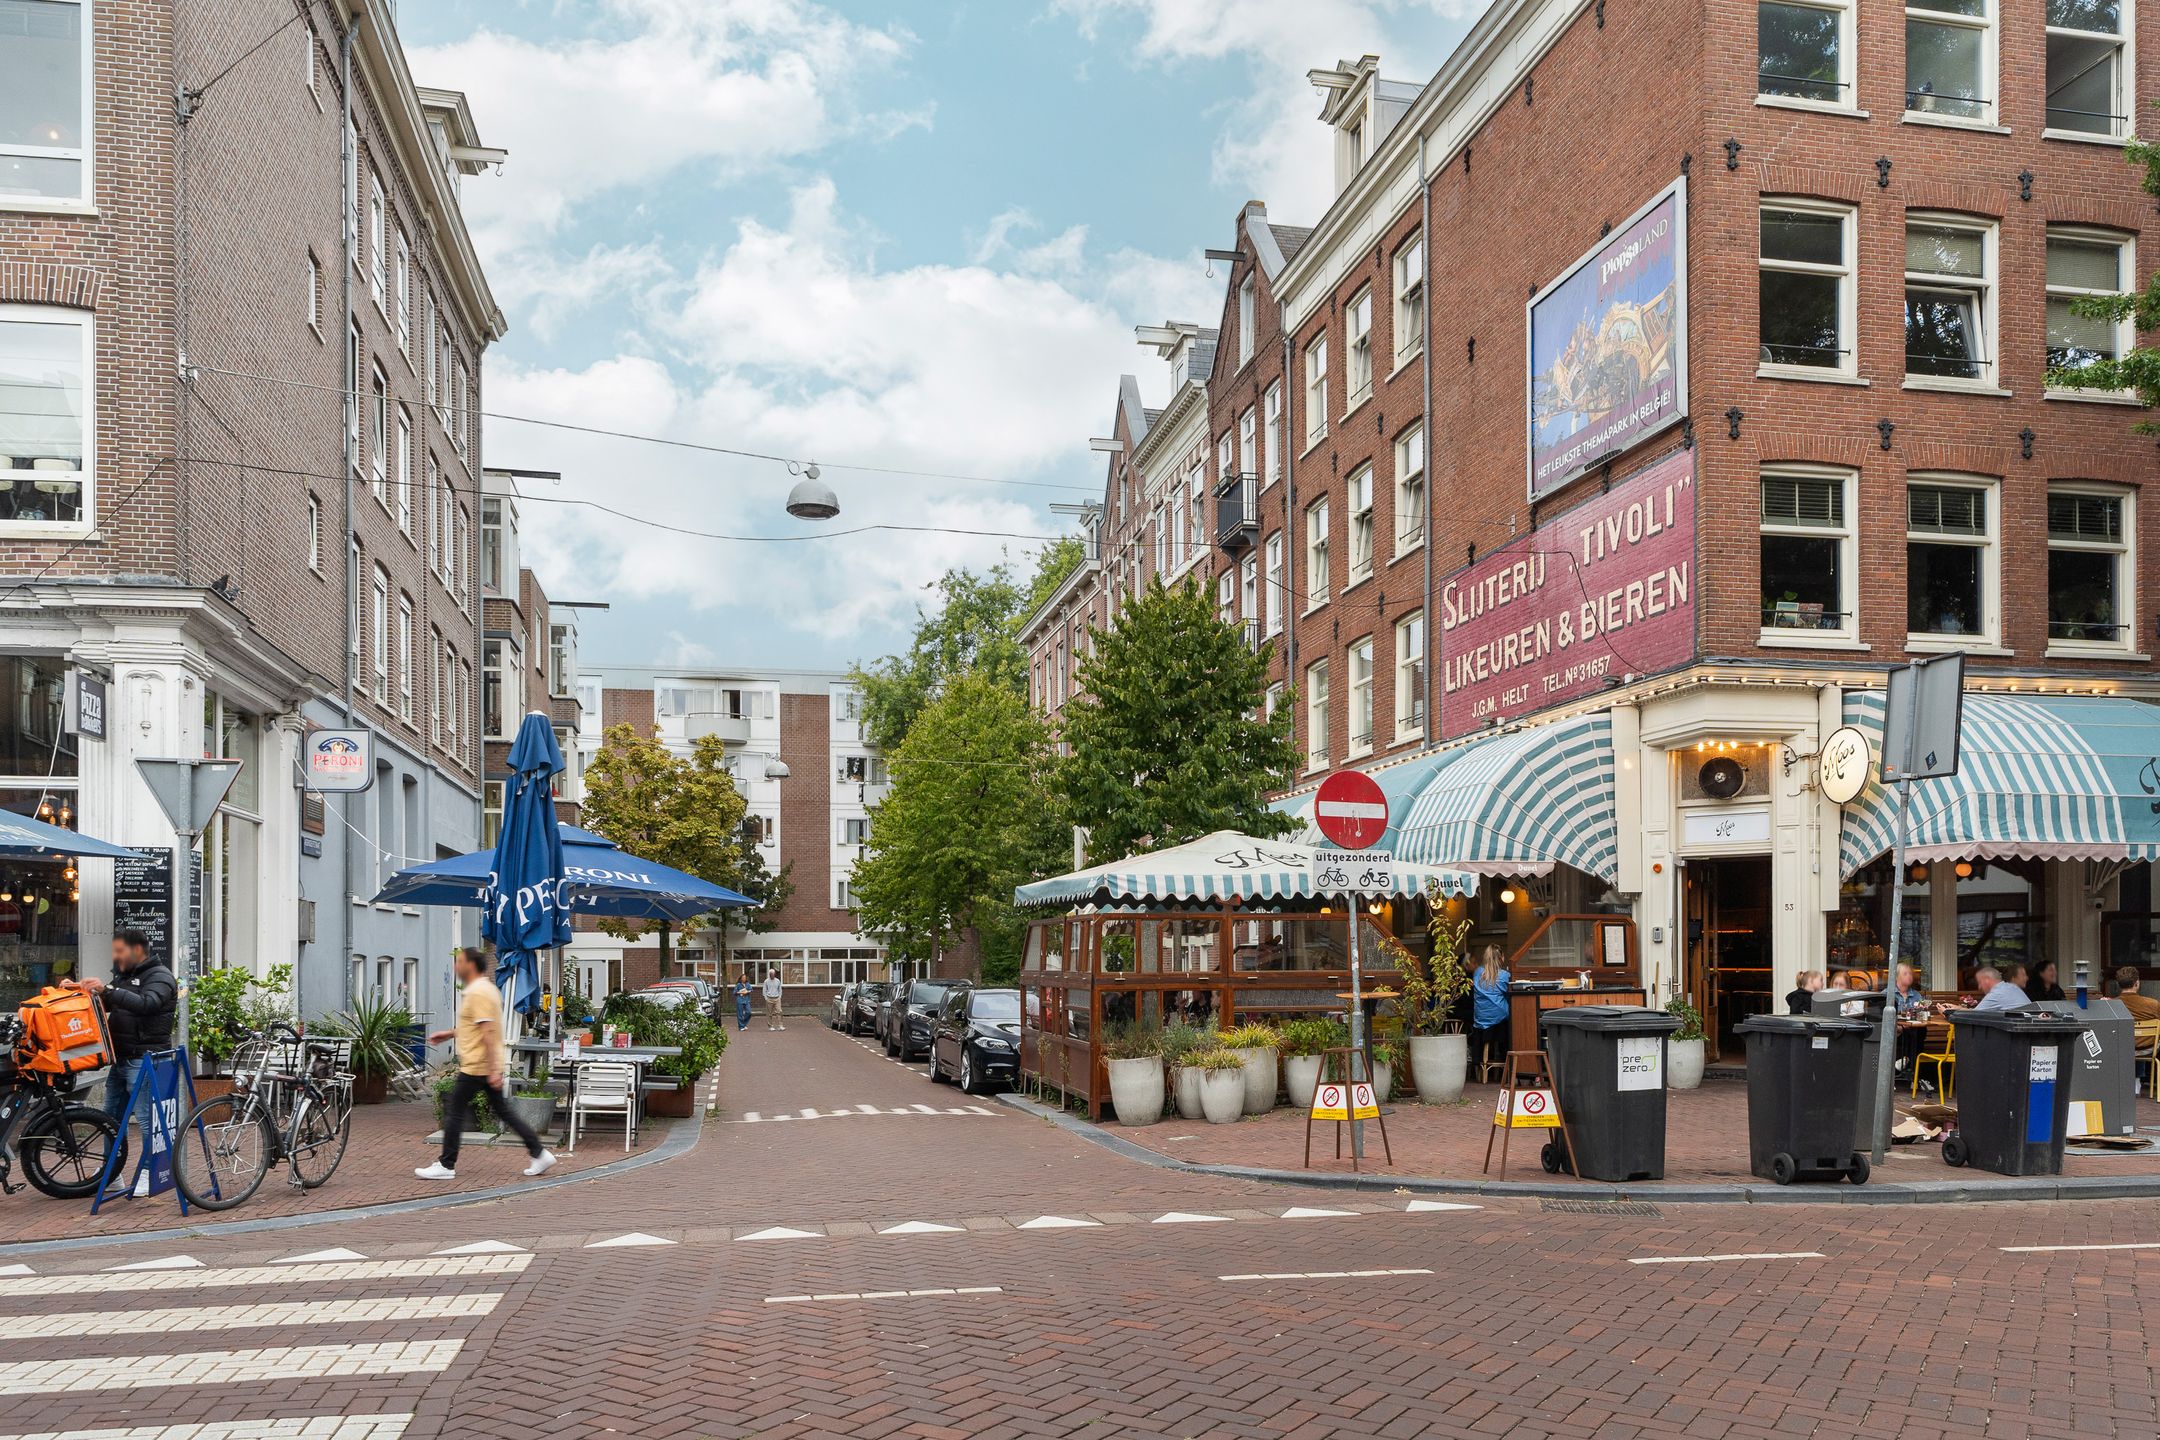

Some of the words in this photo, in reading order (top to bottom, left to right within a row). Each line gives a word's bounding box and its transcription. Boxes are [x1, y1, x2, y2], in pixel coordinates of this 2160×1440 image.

[1537, 462, 1551, 480] HET
[1551, 444, 1582, 472] LEUKSTE
[1582, 417, 1629, 453] THEMAPARK
[1629, 408, 1640, 426] IN
[1443, 550, 1547, 631] SLIJTERIJ
[1445, 617, 1552, 694] LIKEUREN
[1557, 610, 1577, 651] &
[1580, 560, 1690, 643] BIEREN
[1471, 695, 1498, 719] J.G.M.
[1502, 683, 1530, 708] HELT
[313, 754, 363, 766] PERONI
[1824, 739, 1856, 780] Moos
[1715, 819, 1736, 837] Moos
[1316, 853, 1390, 864] uitgezonderd
[1432, 877, 1464, 889] Duvel
[123, 906, 166, 917] Amsterdam
[1784, 903, 1794, 911] 53
[1622, 1055, 1641, 1065] pre
[1622, 1065, 1648, 1073] zero
